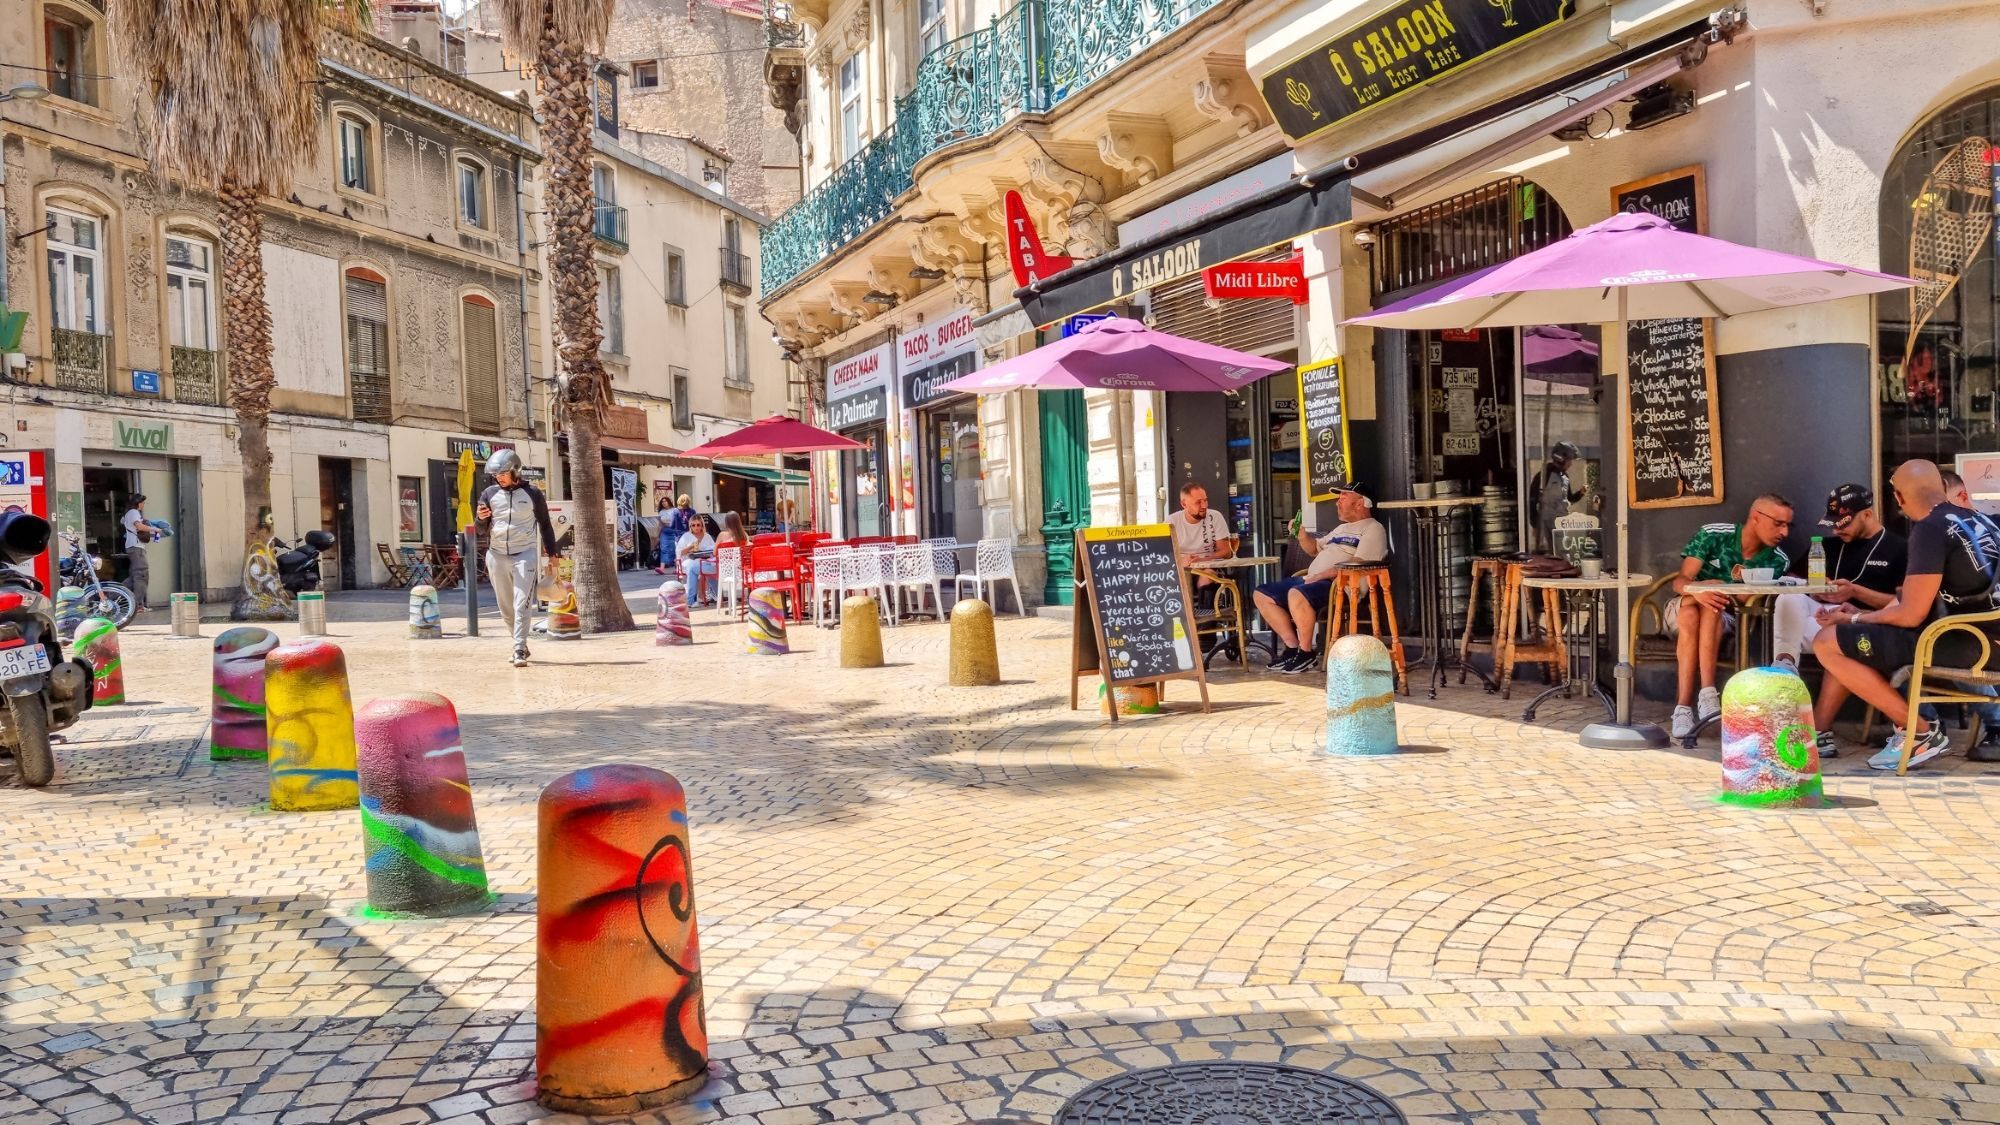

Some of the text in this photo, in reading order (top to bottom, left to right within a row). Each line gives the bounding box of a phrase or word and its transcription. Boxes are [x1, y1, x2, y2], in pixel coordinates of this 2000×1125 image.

[1328, 0, 1457, 86] Ô SALOON
[1111, 238, 1201, 298] Ô SALOON
[1215, 272, 1299, 289] Midi Libre
[1600, 272, 1698, 285] Corona
[903, 333, 929, 359] TACOS
[833, 351, 879, 386] CHEESE NAAN
[1099, 376, 1156, 387] Corona
[831, 394, 879, 428] Le Palmier
[118, 420, 169, 448] Vival
[339, 439, 348, 448] 14
[1560, 519, 1593, 529] Edelweiss
[1106, 527, 1148, 538] Schweppes
[1102, 569, 1175, 588] HAPPY HOUR
[1107, 637, 1125, 648] like
[1136, 642, 1163, 651] Soda
[1108, 648, 1118, 658] it
[1113, 667, 1135, 679] that
